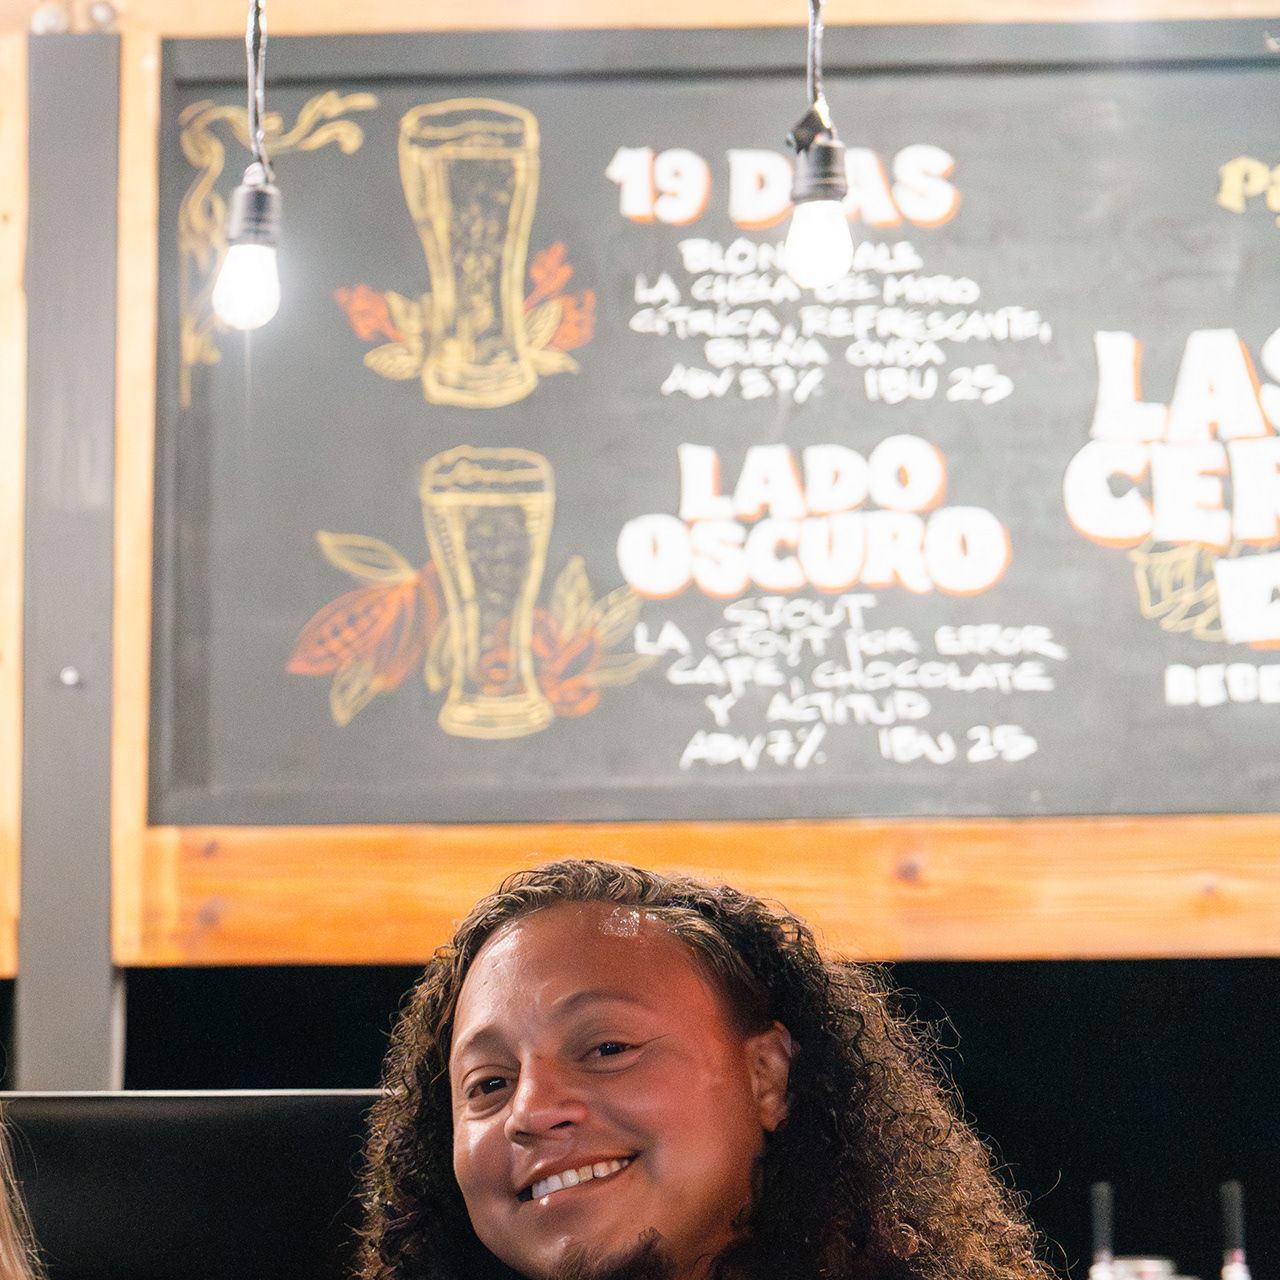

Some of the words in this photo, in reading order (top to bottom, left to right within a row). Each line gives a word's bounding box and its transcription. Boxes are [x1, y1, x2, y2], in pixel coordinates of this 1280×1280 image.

[605, 146, 711, 227] 19
[727, 144, 961, 230] DAS
[633, 272, 681, 305] LA
[1090, 328, 1280, 440] LA
[678, 433, 947, 521] LADO
[616, 506, 1012, 600] OSCURO
[634, 621, 691, 656] LA
[723, 593, 877, 632] STOUT
